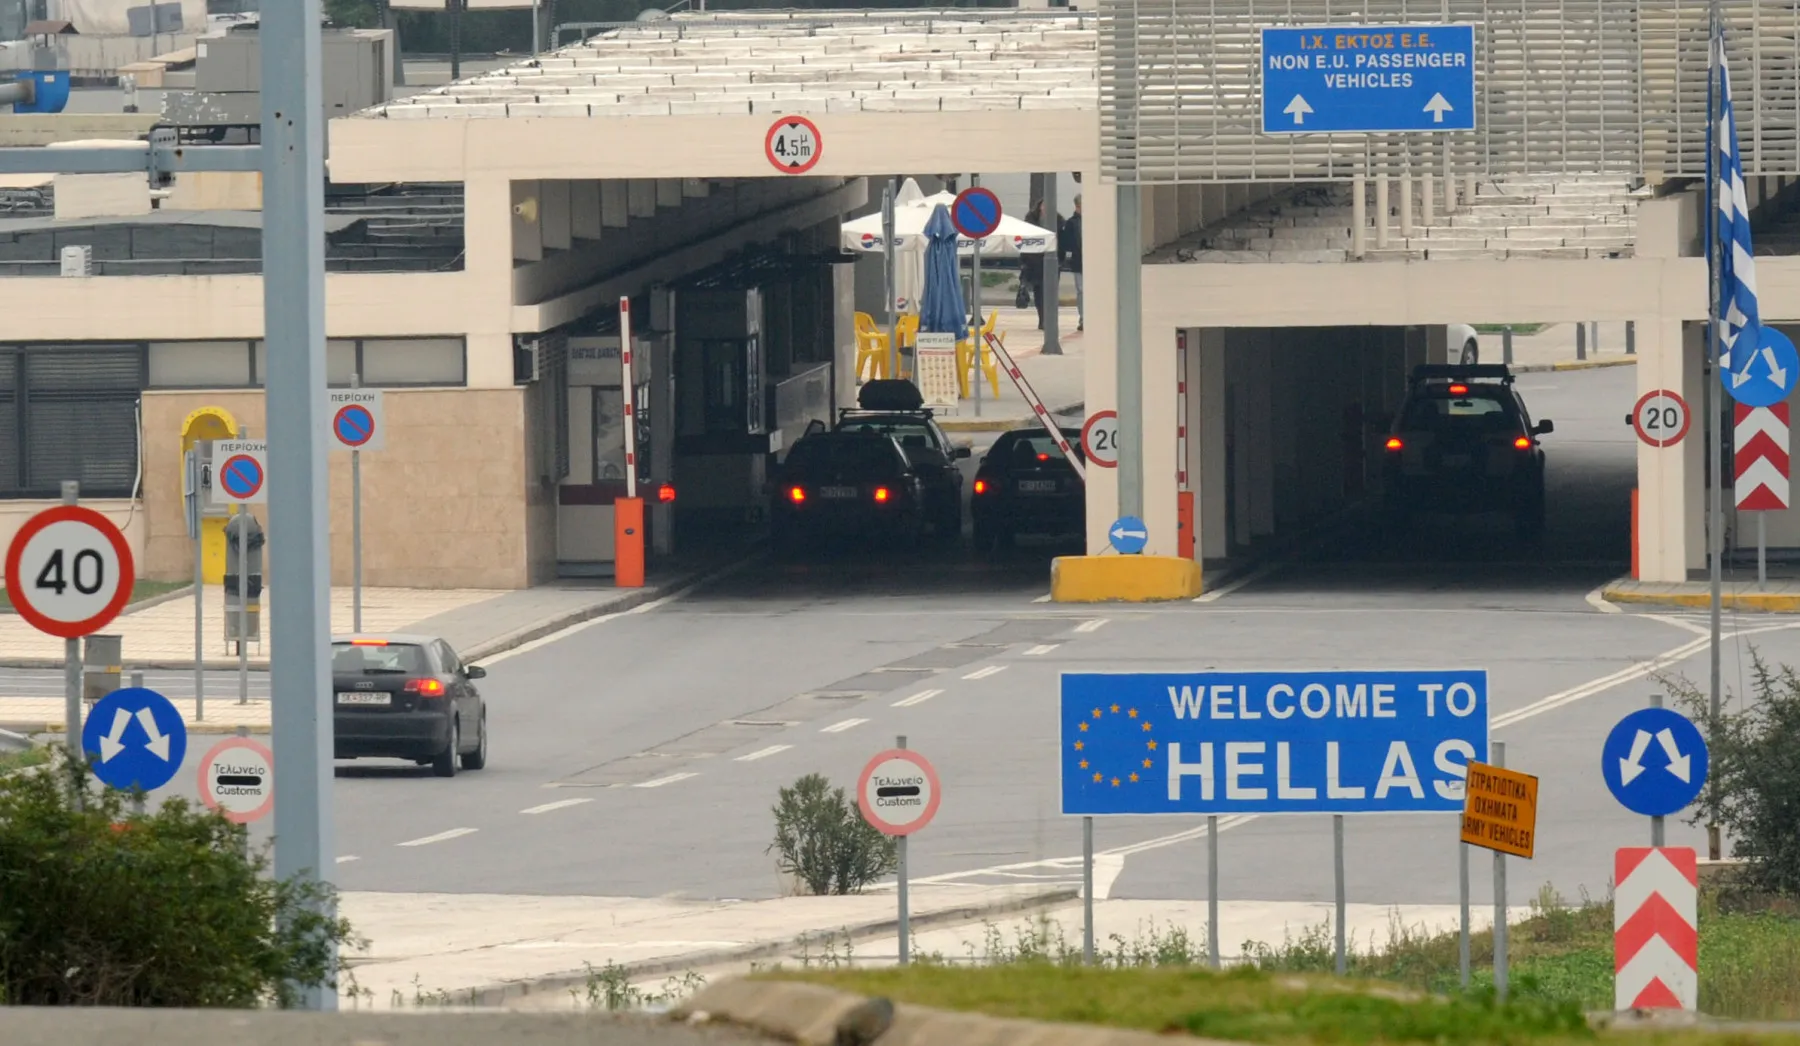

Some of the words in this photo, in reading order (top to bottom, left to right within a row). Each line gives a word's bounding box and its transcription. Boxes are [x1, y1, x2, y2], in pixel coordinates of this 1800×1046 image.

[1335, 34, 1394, 49] ΕΚΤΟΣ
[1269, 55, 1309, 69] NON
[1316, 55, 1349, 68] E.U.
[1356, 53, 1466, 68] PASSENGER
[1324, 73, 1413, 88] VEHICLES
[775, 134, 799, 156] 4.5
[873, 237, 904, 246] PESI
[1647, 407, 1678, 429] 20
[36, 548, 104, 595] 40
[1167, 683, 1397, 720] WELCOME
[1418, 682, 1477, 718] TO
[1167, 739, 1476, 801] HELLAS
[216, 785, 262, 796] Customs
[876, 797, 922, 807] Customs
[1488, 823, 1531, 850] VEHICLES
